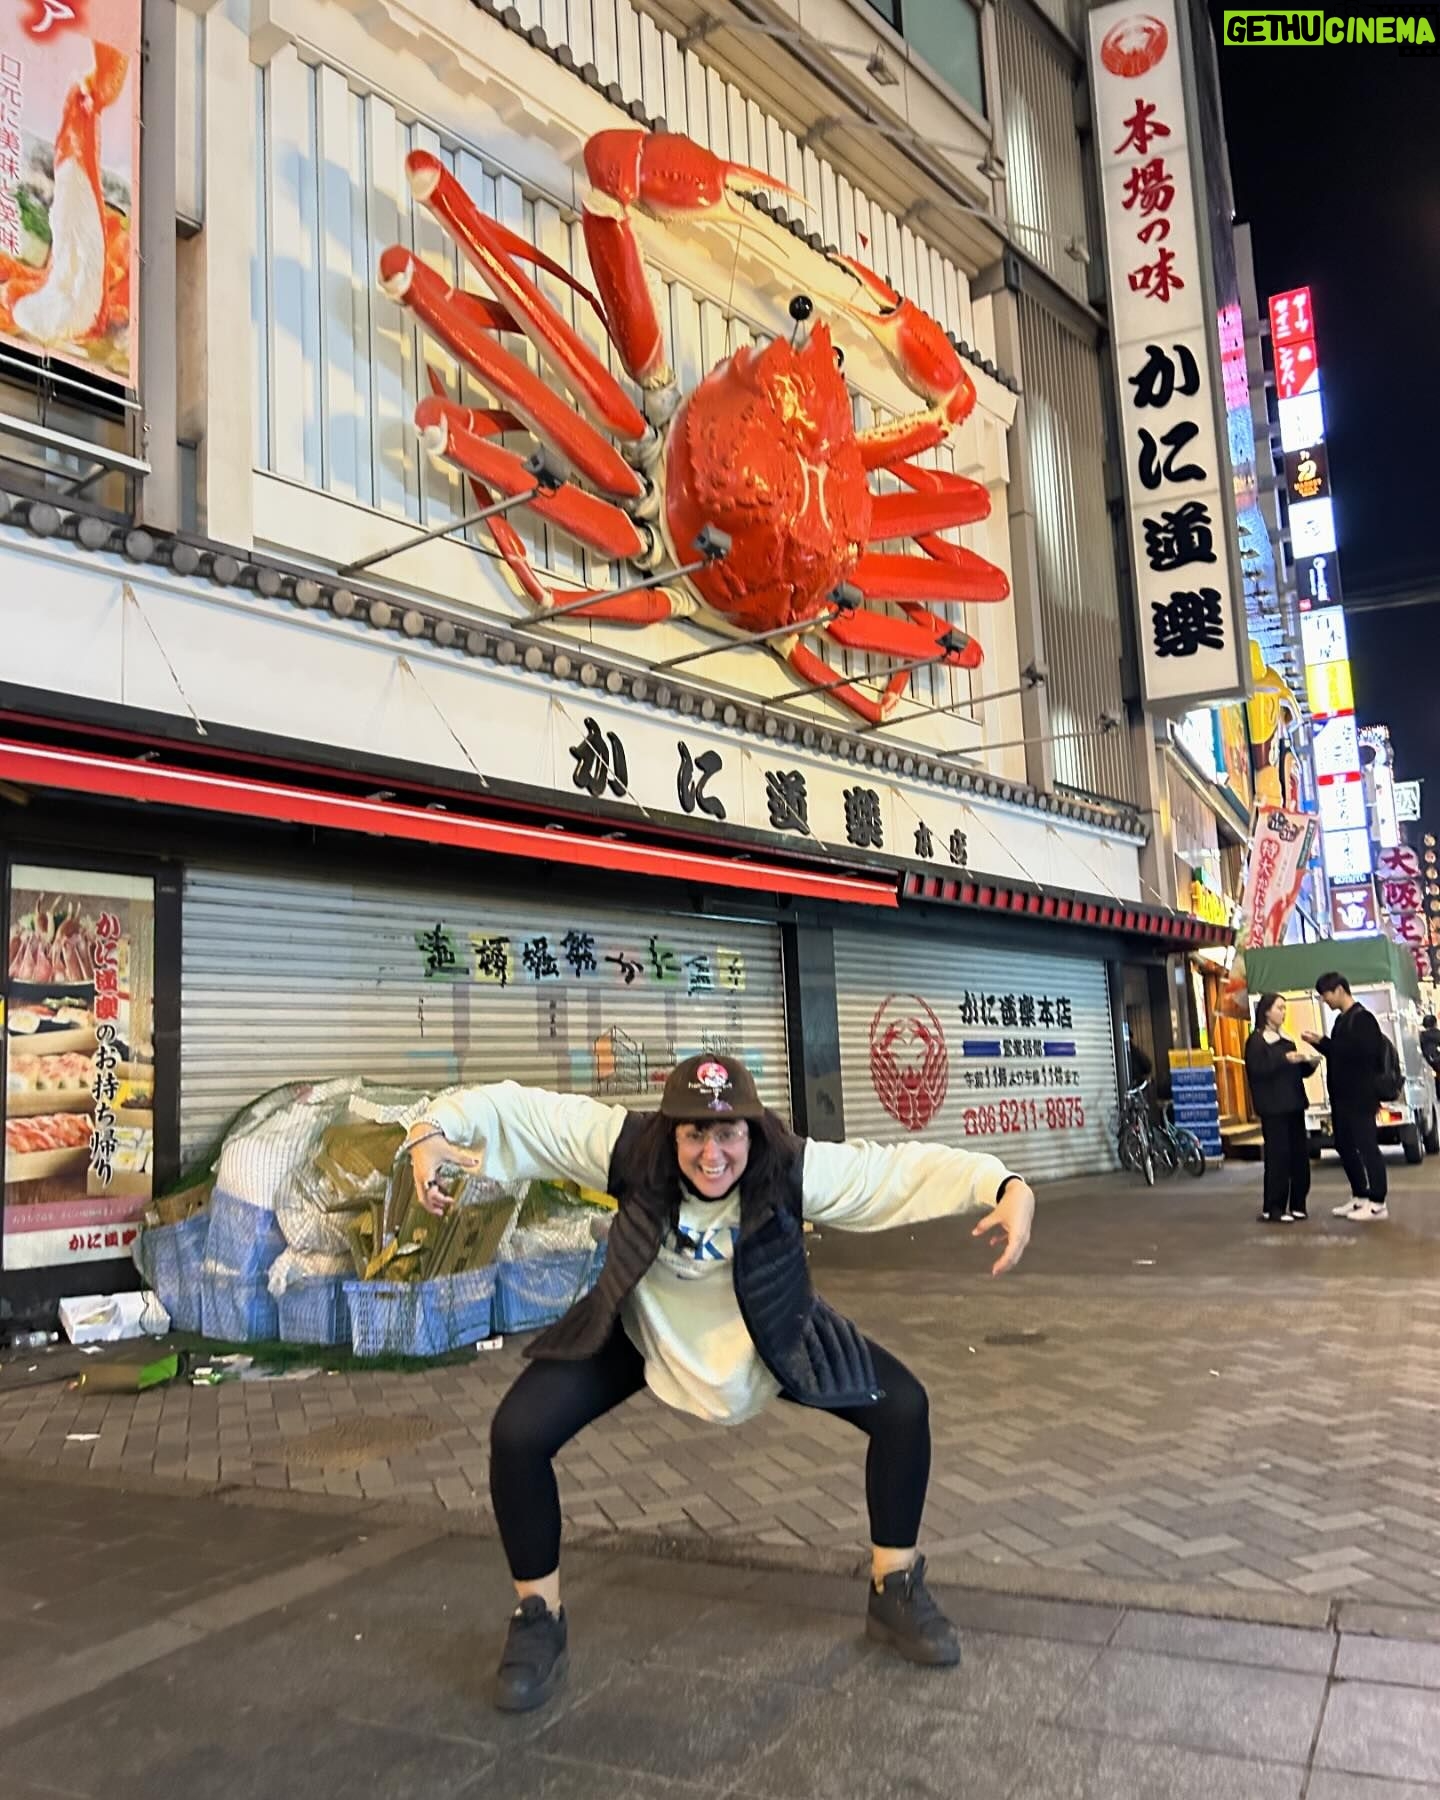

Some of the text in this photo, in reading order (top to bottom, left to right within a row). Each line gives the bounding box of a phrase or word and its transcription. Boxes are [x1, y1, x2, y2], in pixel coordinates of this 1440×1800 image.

[1114, 98, 1225, 657] 本場の味 かに道楽
[569, 717, 883, 848] かに道楽
[91, 914, 120, 1185] かに道楽のお持ち帰り
[959, 990, 1073, 1029] かに道楽本店
